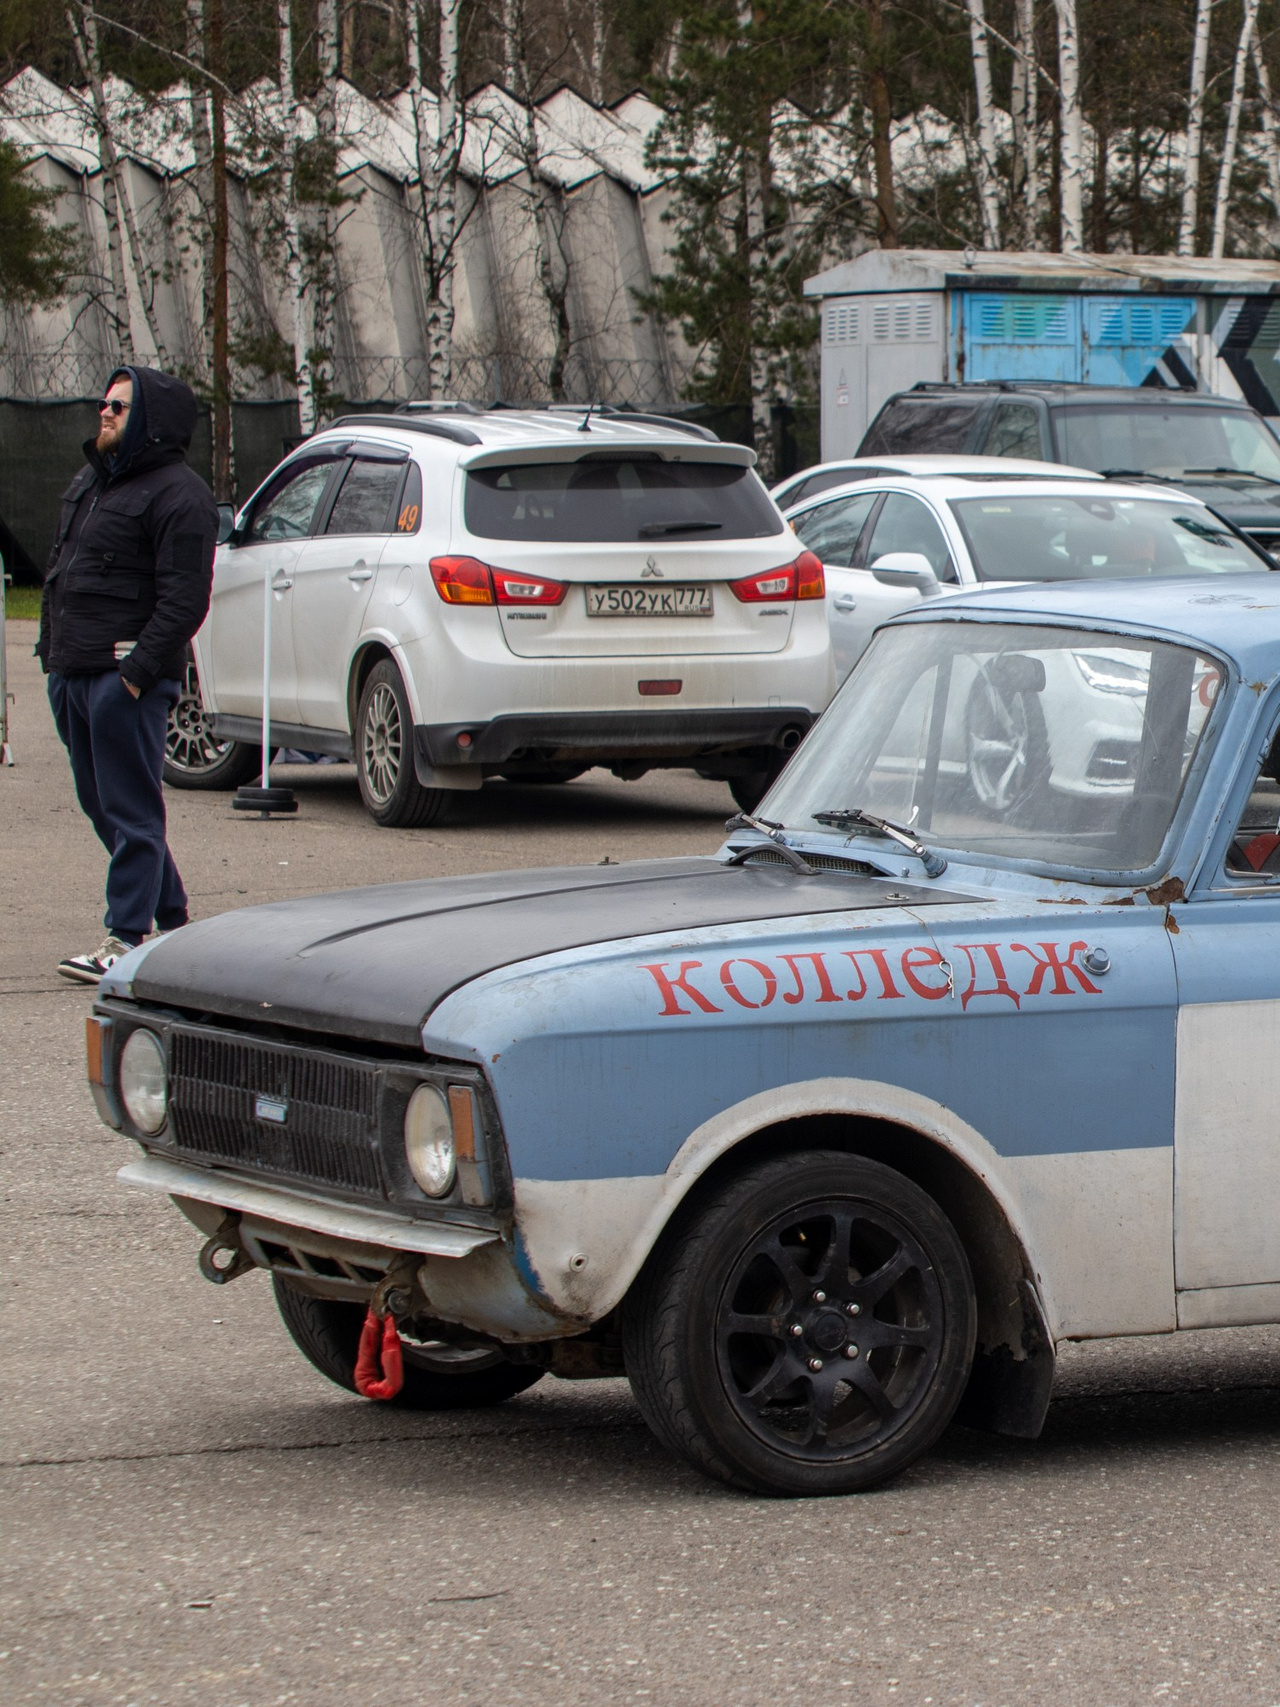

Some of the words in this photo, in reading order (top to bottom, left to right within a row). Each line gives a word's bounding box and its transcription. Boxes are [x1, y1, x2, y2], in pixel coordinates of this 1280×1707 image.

[398, 505, 418, 531] 49
[595, 590, 672, 610] У502УК
[676, 588, 706, 604] 777
